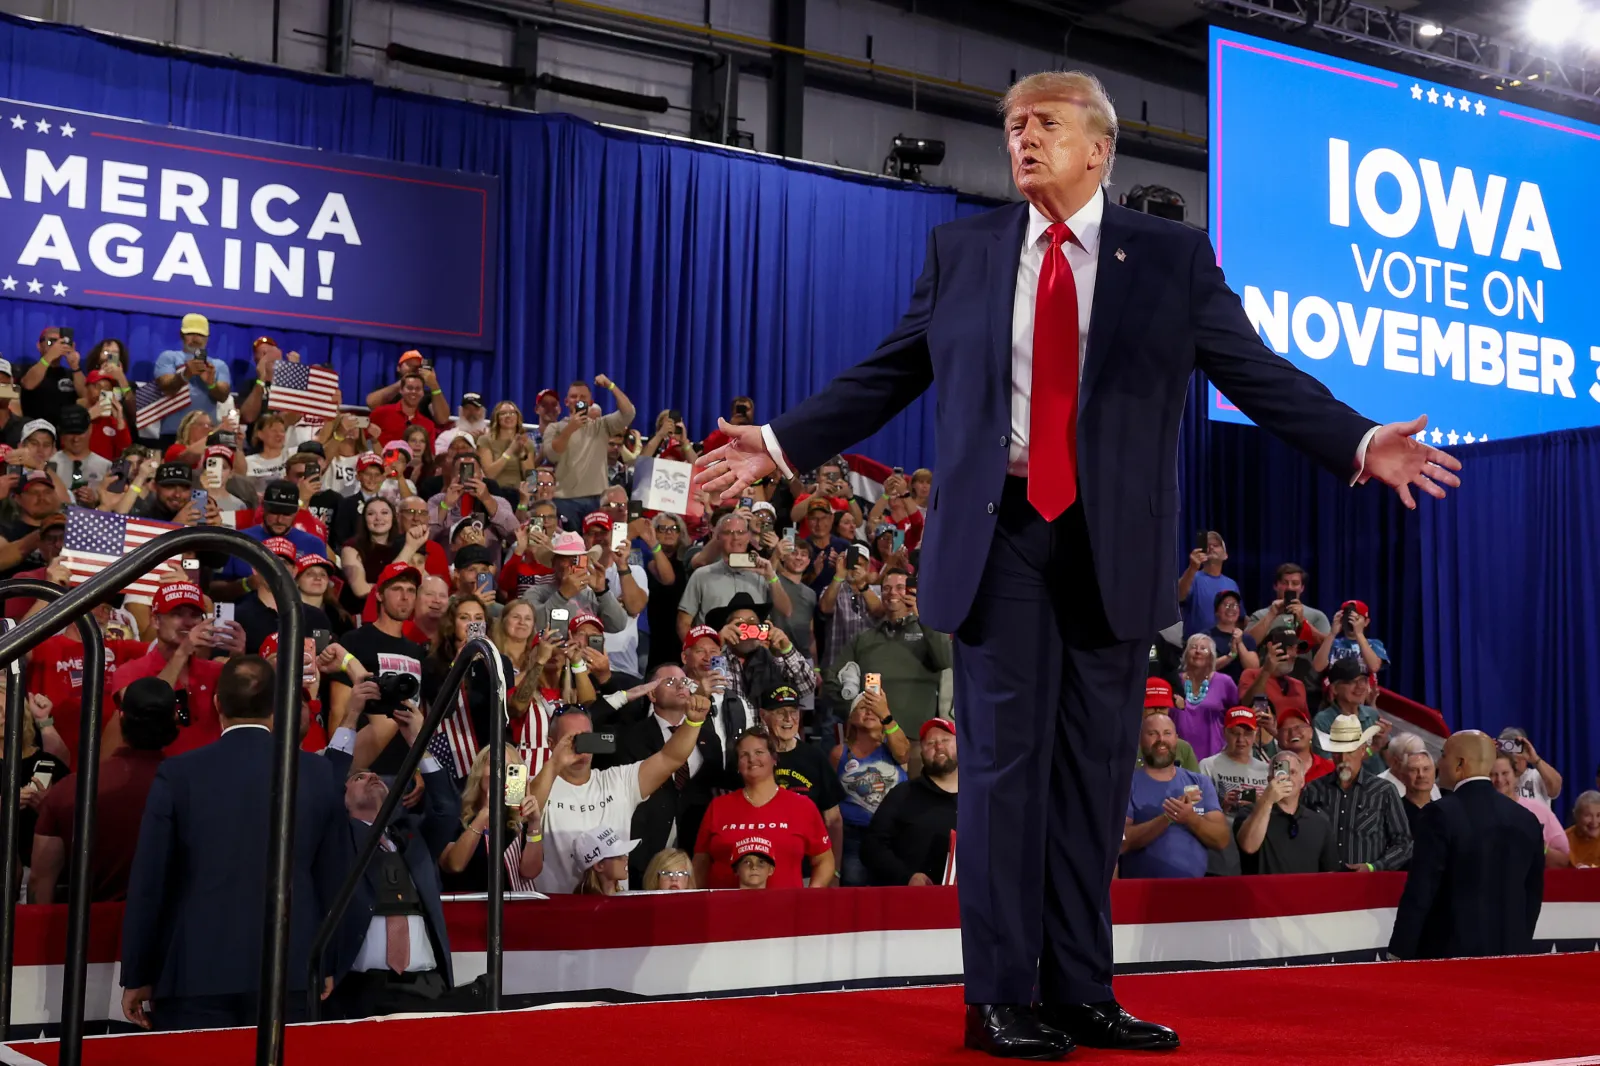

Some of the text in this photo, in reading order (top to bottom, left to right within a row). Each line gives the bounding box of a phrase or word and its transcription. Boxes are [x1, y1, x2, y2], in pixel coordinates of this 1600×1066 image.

[0, 149, 361, 245] MERICA
[1329, 138, 1561, 270] IOWA
[18, 214, 336, 301] AGAIN!
[1352, 244, 1544, 323] VOTE ON
[1243, 286, 1576, 398] NOVEMBER
[547, 795, 614, 812] FREEDOM
[791, 771, 813, 788] CORPS
[722, 822, 788, 831] FREEDOM
